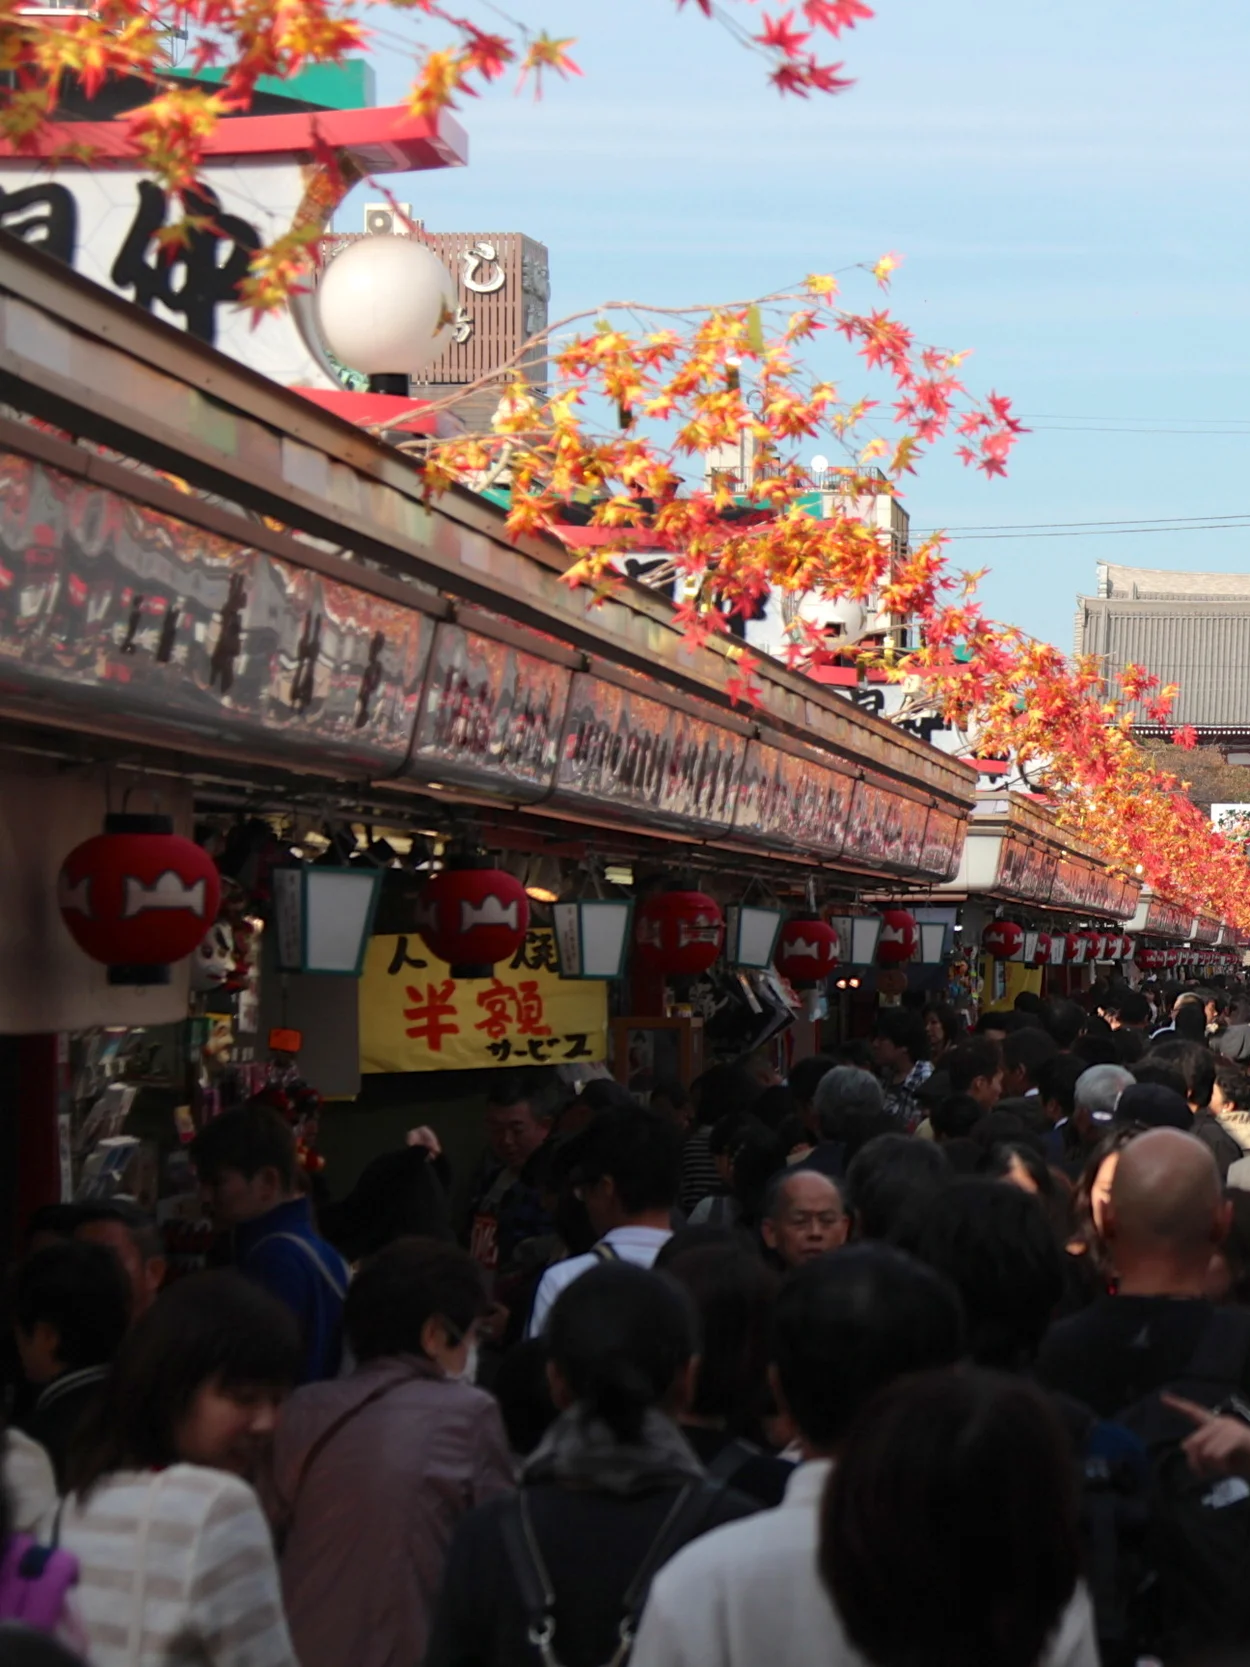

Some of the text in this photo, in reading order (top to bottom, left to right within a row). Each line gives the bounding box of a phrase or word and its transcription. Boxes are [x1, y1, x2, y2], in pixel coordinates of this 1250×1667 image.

[403, 979, 553, 1052] 半額
[485, 1033, 594, 1062] サービス
